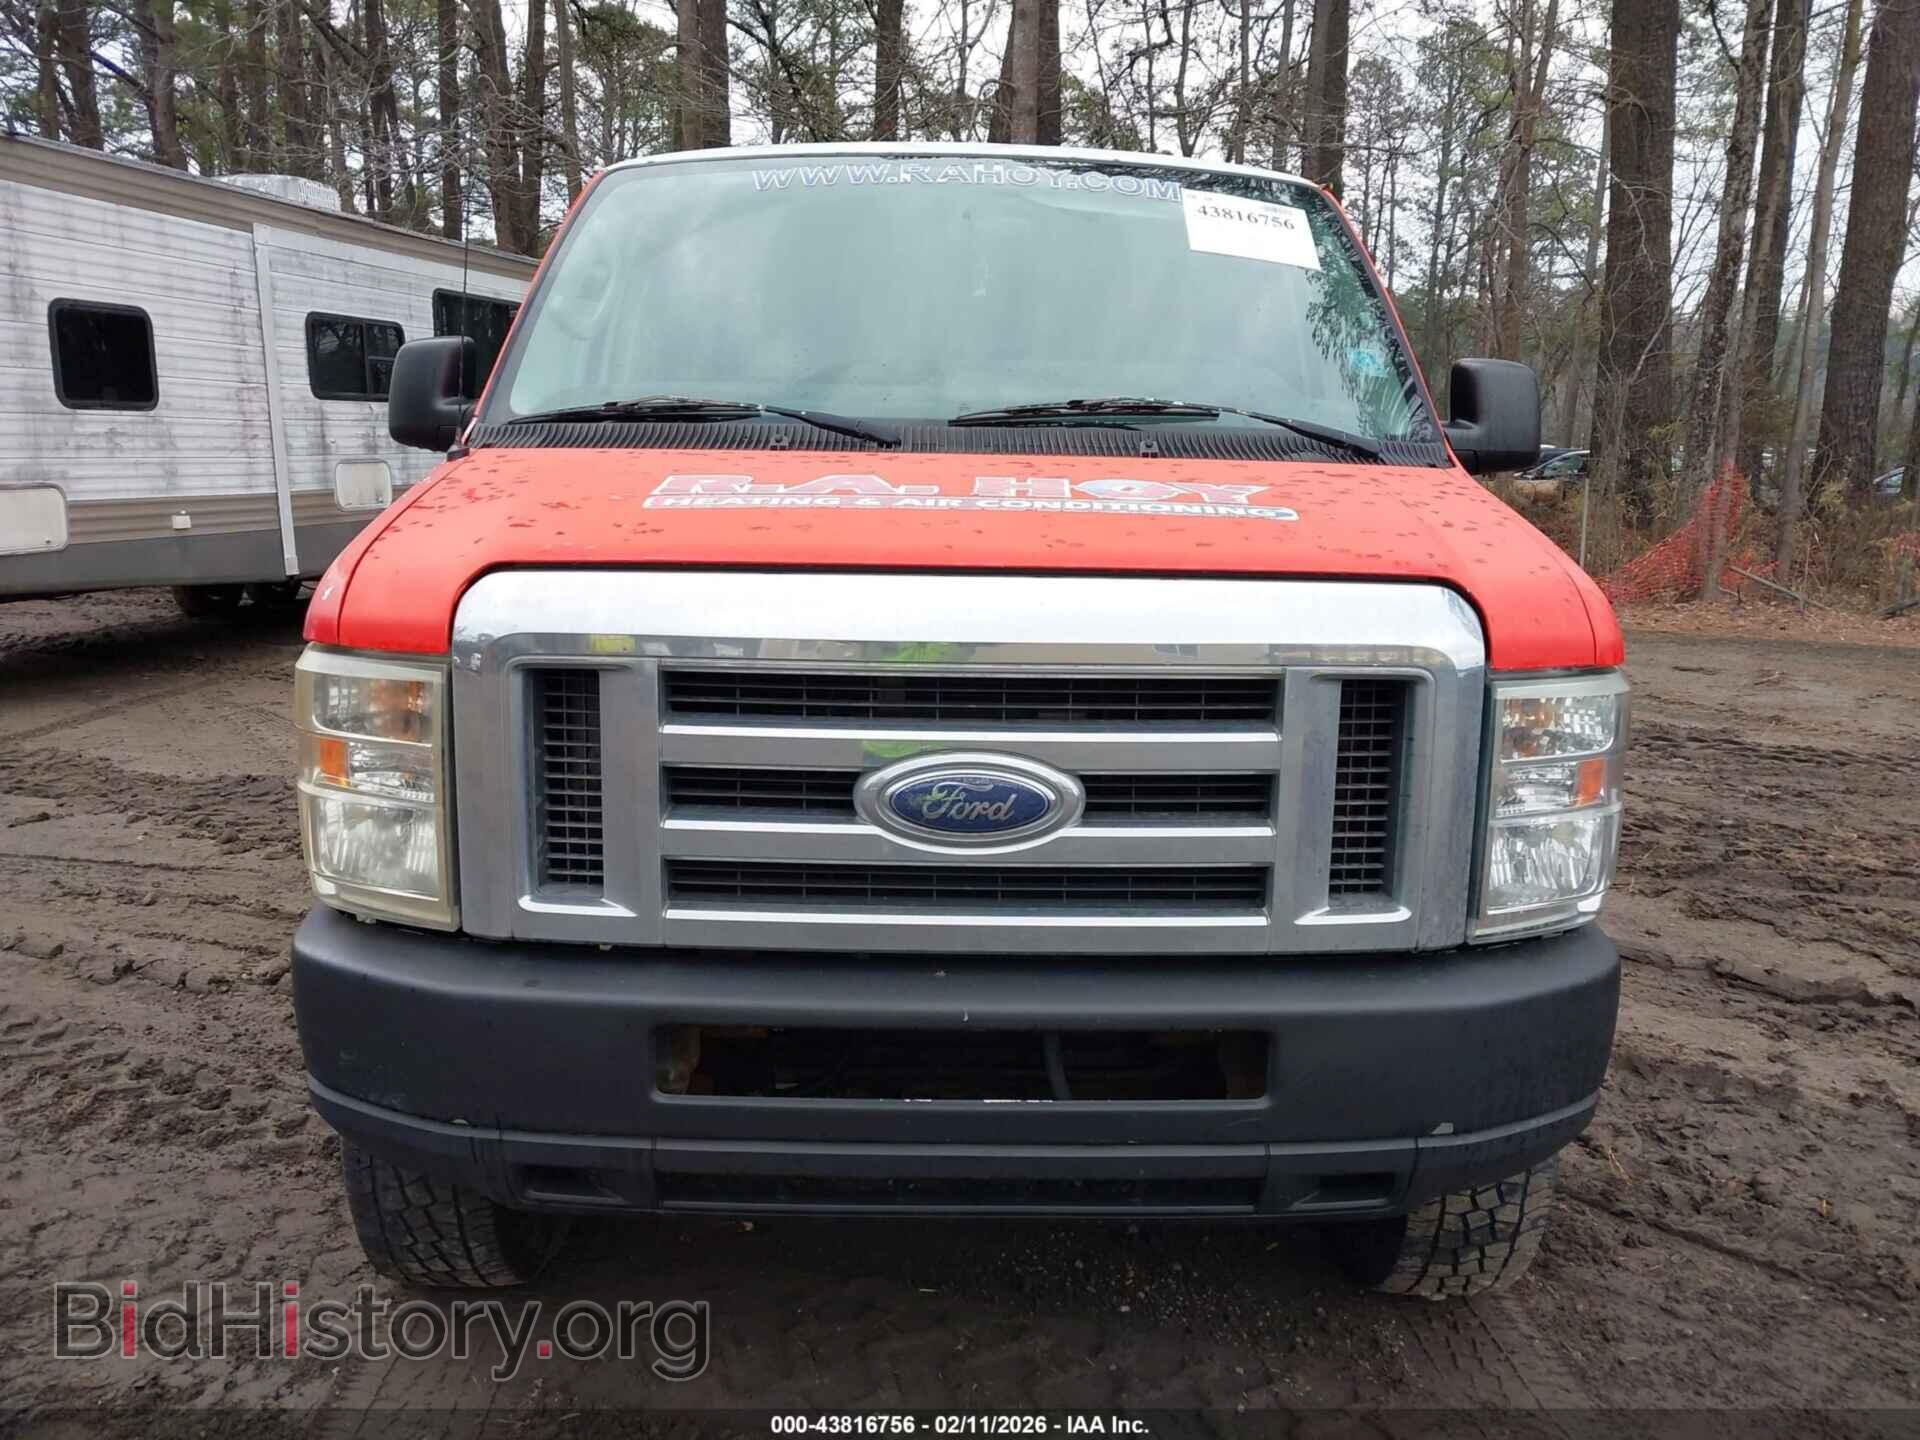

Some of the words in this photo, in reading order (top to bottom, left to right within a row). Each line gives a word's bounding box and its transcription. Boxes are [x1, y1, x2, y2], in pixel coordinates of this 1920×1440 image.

[752, 164, 1182, 202] WWW.RAHOY.COM
[1196, 203, 1296, 232] 43816756
[972, 476, 1271, 503] HOY
[662, 495, 840, 507] HEATING
[856, 496, 881, 507] &
[894, 497, 963, 508] AIR
[975, 499, 1289, 518] CONDITIONING
[921, 780, 1016, 821] Ford
